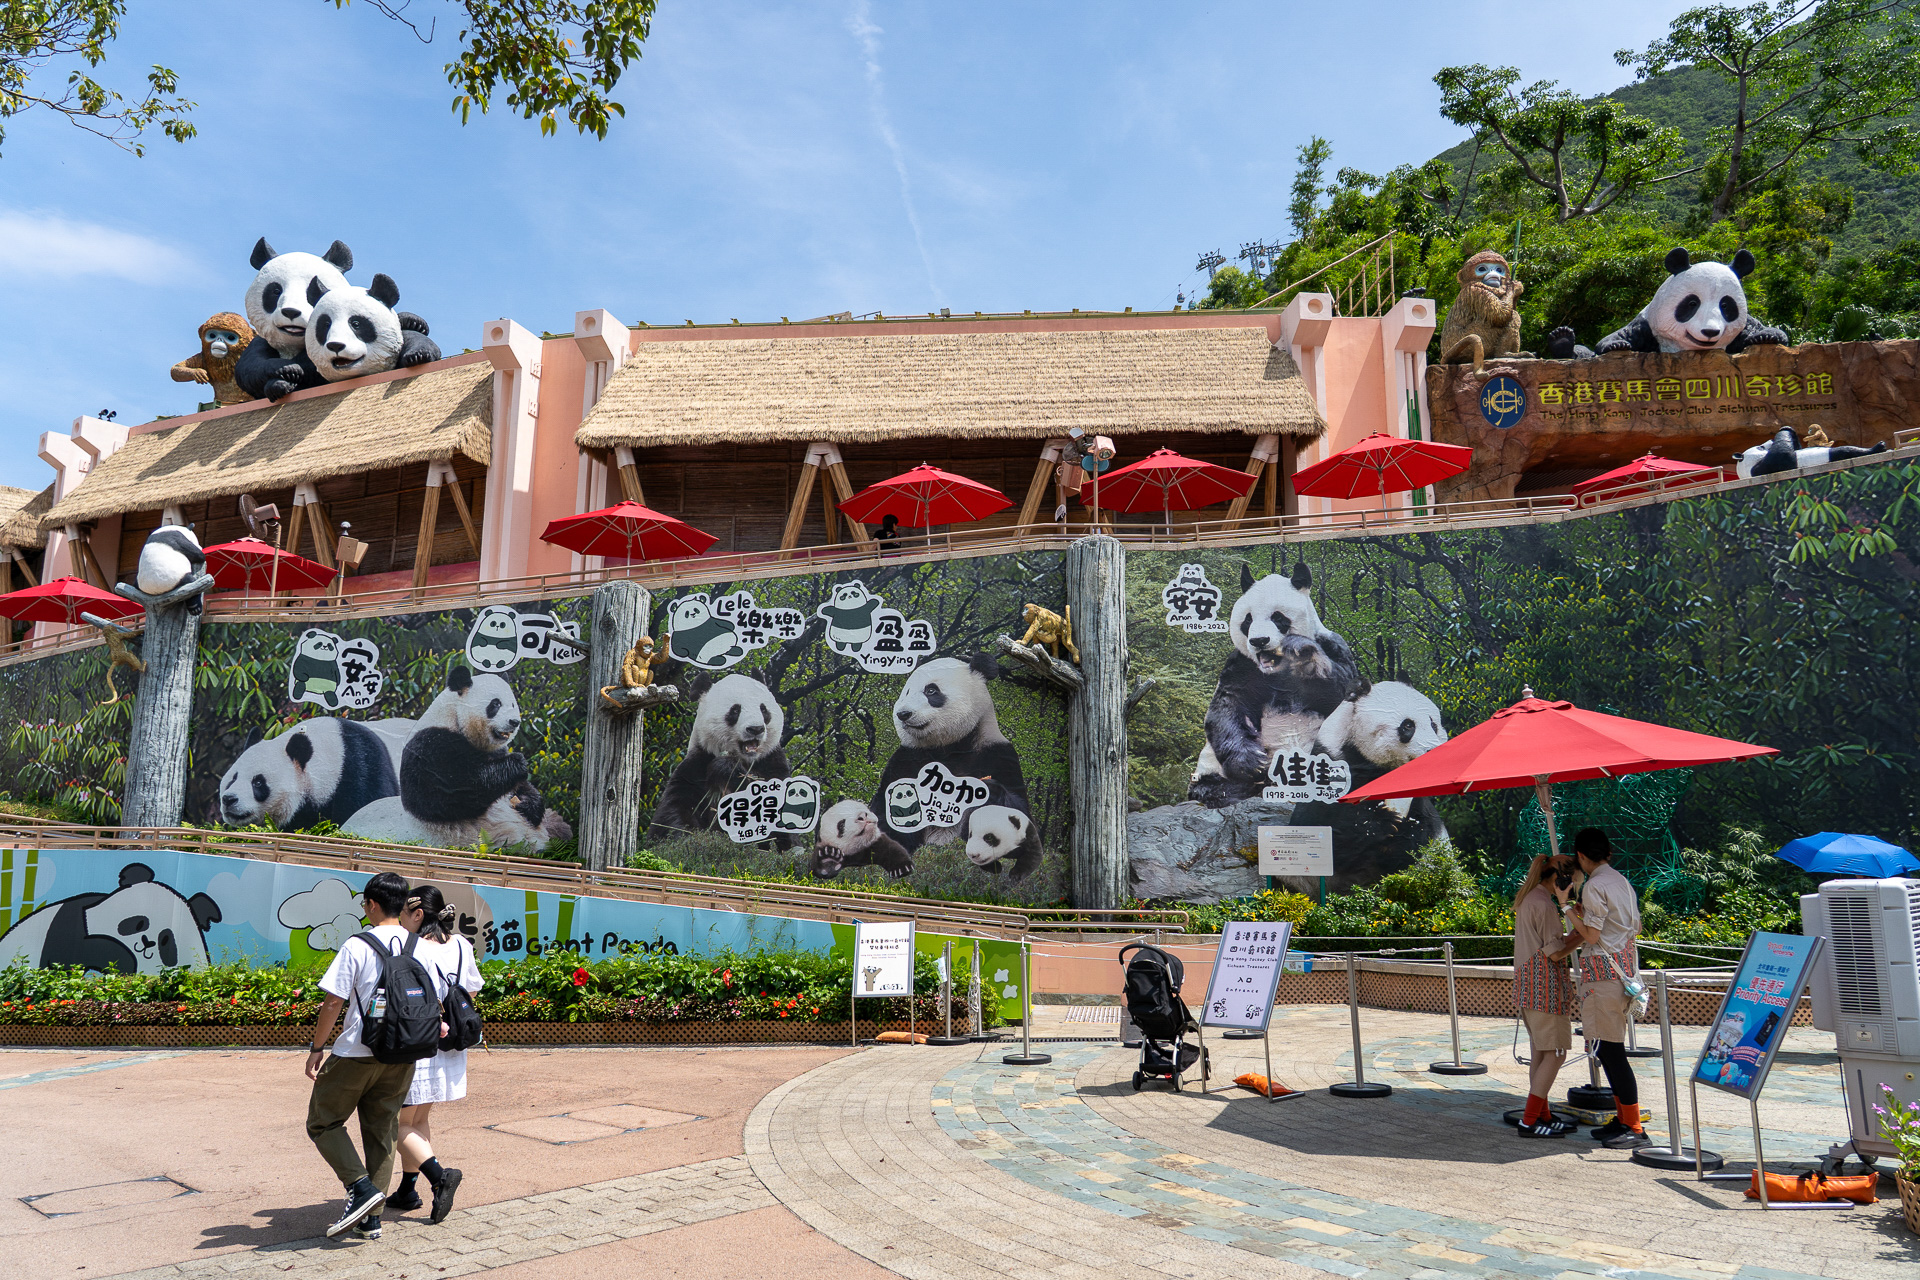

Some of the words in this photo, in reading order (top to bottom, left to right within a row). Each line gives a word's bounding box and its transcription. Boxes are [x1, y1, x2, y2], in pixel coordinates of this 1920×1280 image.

[1538, 372, 1833, 405] 香港賽馬會四川奇珍館
[1540, 410, 1564, 420] The
[1569, 410, 1599, 420] Hong
[1604, 408, 1632, 420] Kong
[1640, 407, 1683, 418] Jockey
[1686, 405, 1712, 415] Club
[1718, 404, 1768, 414] Sichuan
[1772, 402, 1837, 412] Treasures
[737, 609, 802, 644] 樂樂
[874, 615, 931, 652] 盈盈
[920, 764, 987, 804] 加加
[1273, 751, 1331, 787] 佳佳
[720, 796, 778, 828] 得得
[526, 931, 594, 956] Giant
[601, 931, 679, 956] Panda
[1733, 986, 1762, 1005] Priority
[1761, 992, 1790, 1008] Access
[1750, 976, 1785, 994] 優先通行
